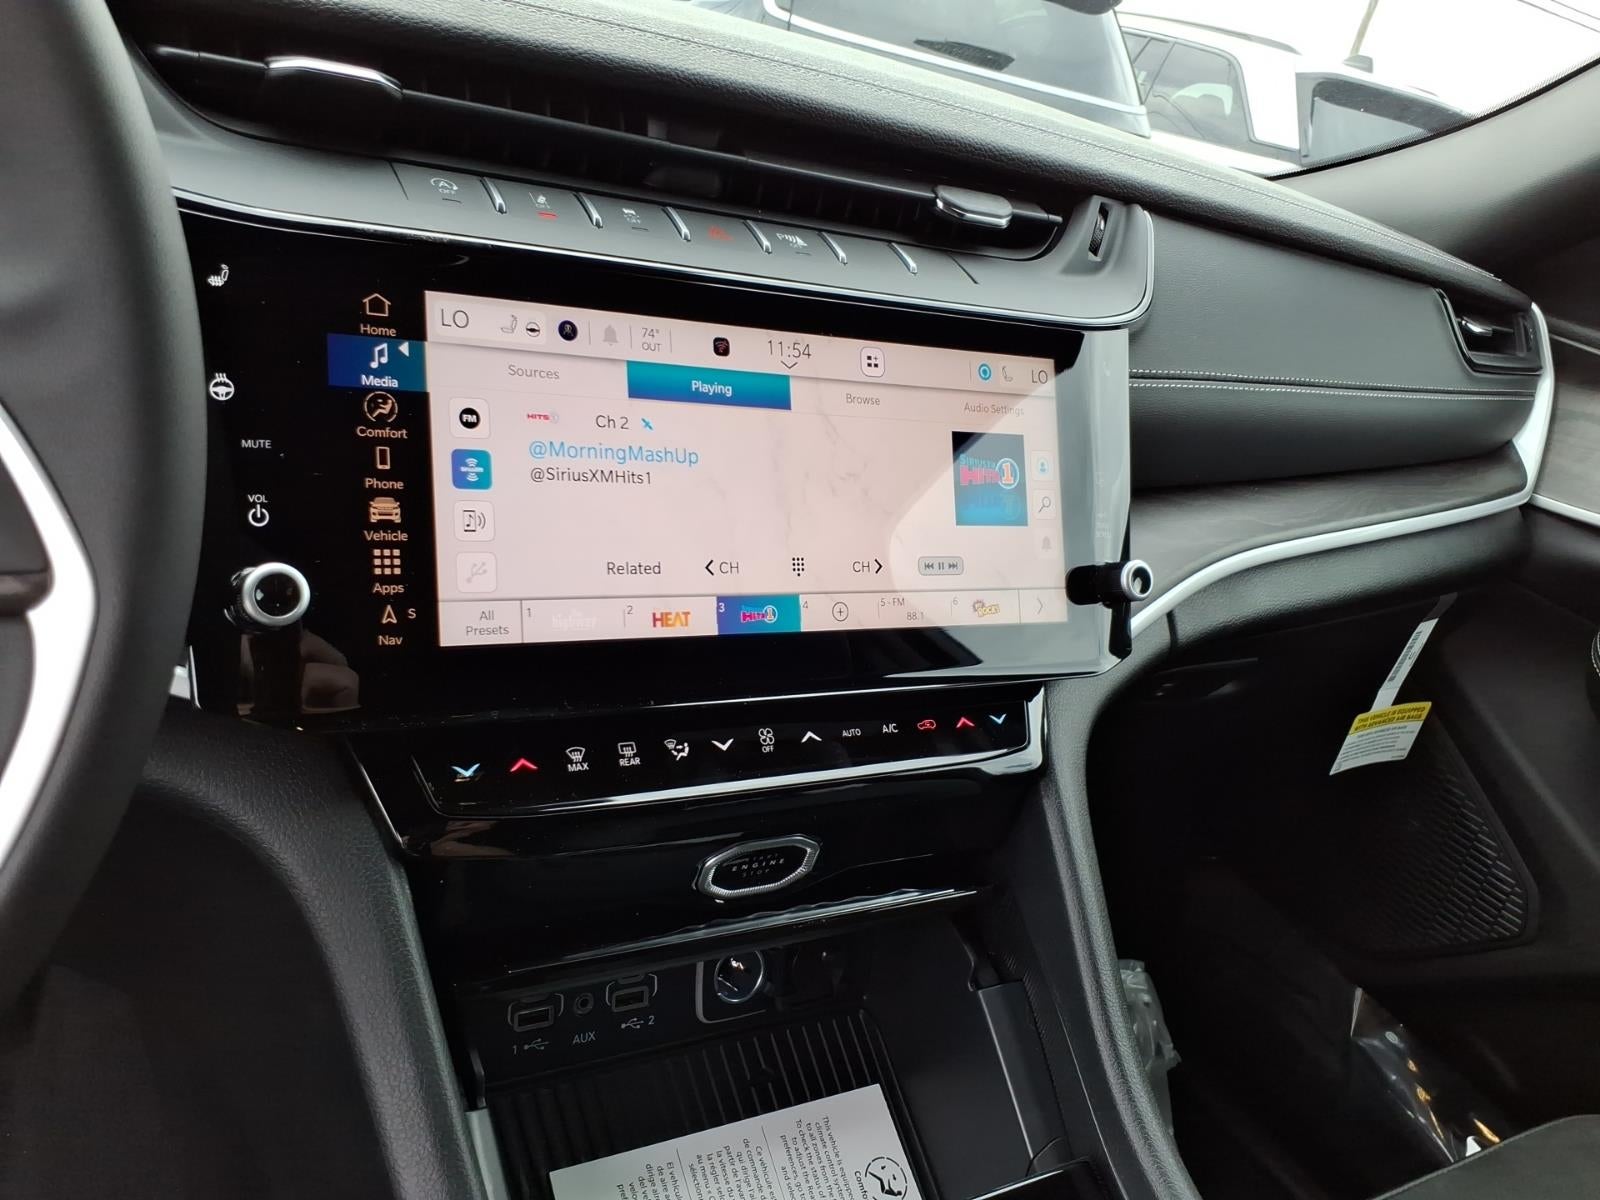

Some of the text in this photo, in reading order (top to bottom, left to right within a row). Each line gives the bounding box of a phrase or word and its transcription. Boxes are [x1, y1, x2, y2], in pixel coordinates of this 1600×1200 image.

[441, 308, 469, 328] LO
[360, 324, 396, 337] Home
[641, 342, 662, 352] OUT
[768, 340, 812, 359] 11:54
[508, 364, 560, 380] Sources
[1031, 369, 1048, 384] LO
[361, 374, 398, 388] Media
[691, 380, 732, 397] Playing
[846, 393, 881, 406] Browse
[964, 402, 1024, 417] Audio Settings
[462, 414, 478, 423] FM
[595, 415, 629, 430] Ch 2
[356, 426, 408, 439] Comfort
[241, 439, 272, 449] MUTE
[529, 441, 699, 467] @MorningMashUp
[530, 467, 651, 485] @SiriusXMHits1
[365, 477, 404, 490] Phone
[247, 494, 268, 503] VOL
[363, 529, 409, 542] Vehicle
[606, 561, 662, 575] Related
[719, 561, 740, 574] CH
[852, 560, 871, 573] CH
[372, 583, 405, 596] Apps
[718, 602, 725, 613] 3
[802, 601, 809, 609] 4
[952, 596, 959, 606] 6
[407, 608, 417, 619] S
[479, 610, 495, 621] All
[627, 605, 633, 615] 2
[906, 611, 924, 621] 88.1
[652, 611, 691, 628] HEAT
[465, 624, 509, 636] Presets
[378, 635, 403, 646] Nav
[842, 728, 862, 738] AUTO
[882, 723, 898, 734] A/C
[761, 745, 774, 753] OFF
[567, 762, 589, 772] MAX
[619, 757, 641, 767] REAR
[648, 1015, 655, 1025] 2
[572, 1031, 597, 1045] AUX
[743, 1138, 750, 1148] de
[823, 1116, 831, 1131] This
[828, 1132, 839, 1158] vehicle
[815, 1122, 827, 1149] climate
[824, 1150, 838, 1177] control
[707, 1153, 713, 1161] la
[723, 1145, 735, 1166] partir
[731, 1168, 739, 1178] de
[736, 1152, 745, 1164] qui
[792, 1137, 798, 1145] to
[802, 1171, 810, 1184] the
[798, 1130, 810, 1152] check
[811, 1167, 821, 1189] status
[806, 1122, 812, 1131] to
[812, 1142, 822, 1164] zones
[820, 1165, 829, 1184] from
[826, 1184, 834, 1197] the
[657, 1166, 664, 1176] de
[696, 1154, 703, 1164] au
[700, 1166, 710, 1189] menu
[716, 1150, 722, 1158] la
[719, 1158, 730, 1185] vitesse
[746, 1150, 763, 1193] commande
[781, 1166, 791, 1180] and
[638, 1176, 647, 1188] del
[660, 1178, 668, 1192] aire
